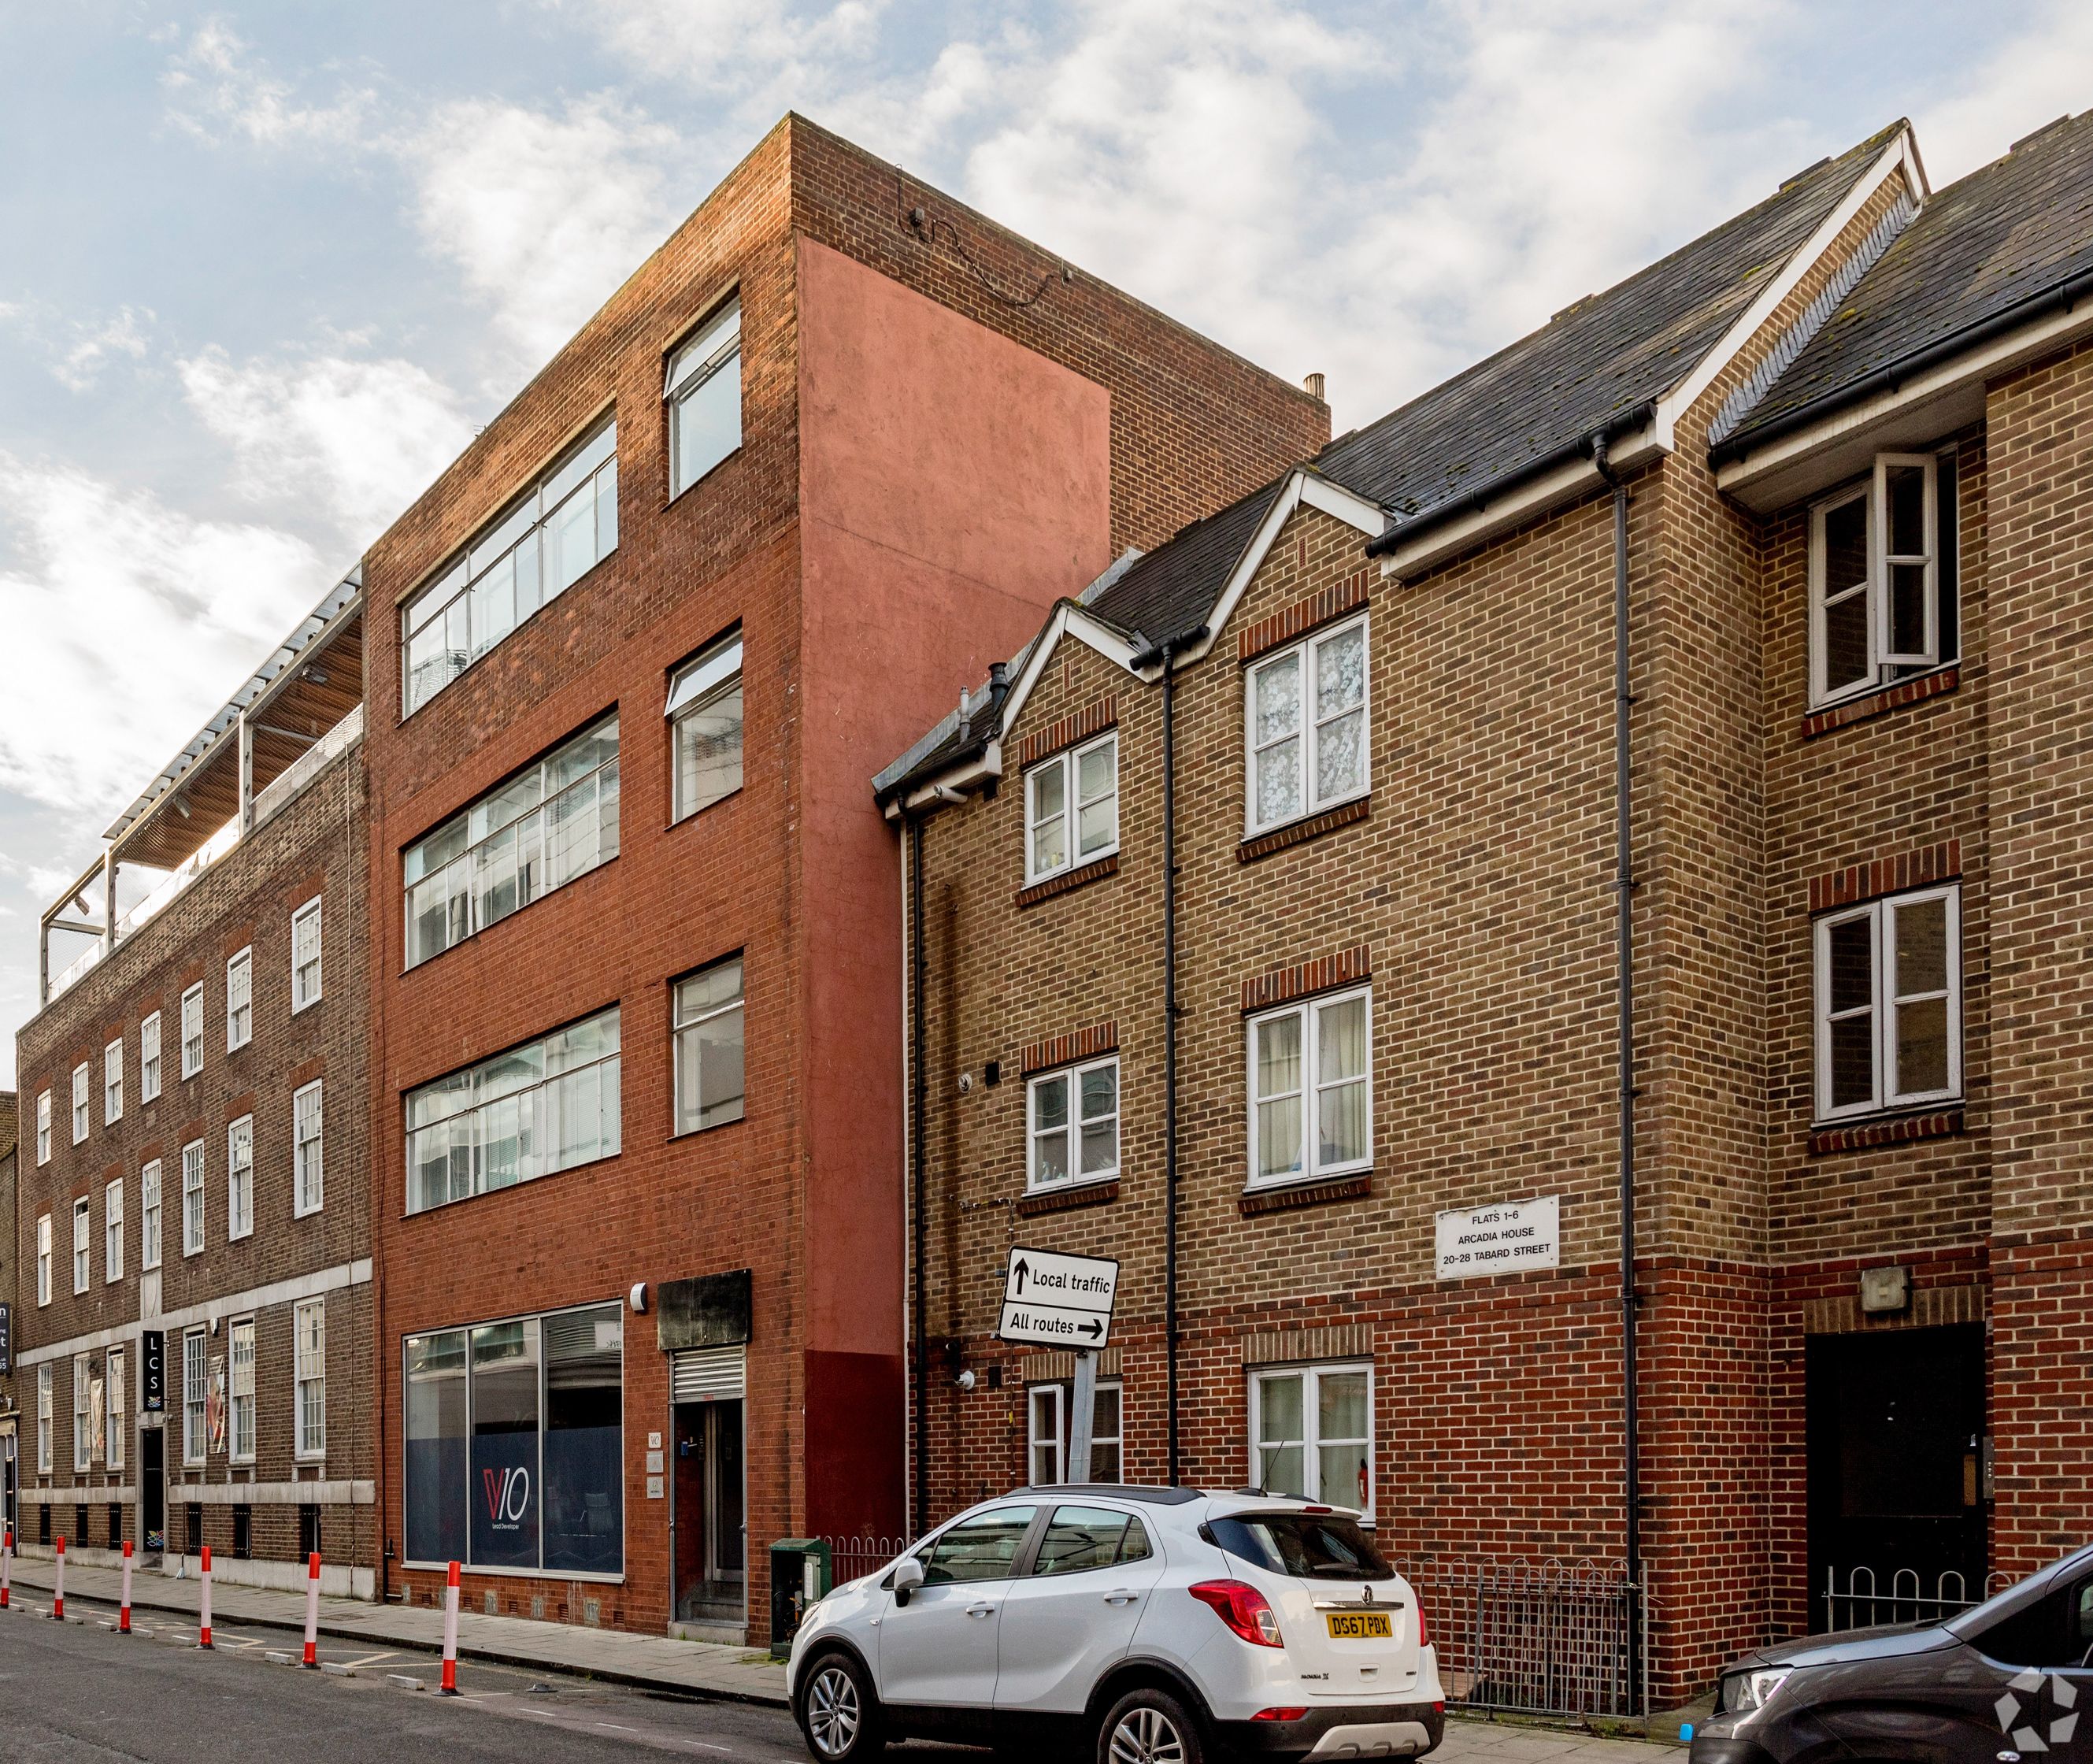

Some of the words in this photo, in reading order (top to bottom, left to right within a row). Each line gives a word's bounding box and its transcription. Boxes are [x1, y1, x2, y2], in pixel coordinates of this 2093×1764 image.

[1473, 1213, 1500, 1225] FLATS
[1504, 1210, 1519, 1221] 1-6
[1458, 1232, 1498, 1245] ARCADIA
[1502, 1227, 1535, 1240] HOUSE
[1443, 1254, 1471, 1265] 20-28
[1474, 1248, 1510, 1261] TABARD
[1513, 1243, 1551, 1257] STREET
[1032, 1269, 1067, 1289] Local
[1071, 1274, 1110, 1294] traffic
[1009, 1312, 1029, 1330] All
[1032, 1317, 1074, 1334] routes
[149, 1337, 158, 1389] LCS
[1332, 1617, 1365, 1635] DS67
